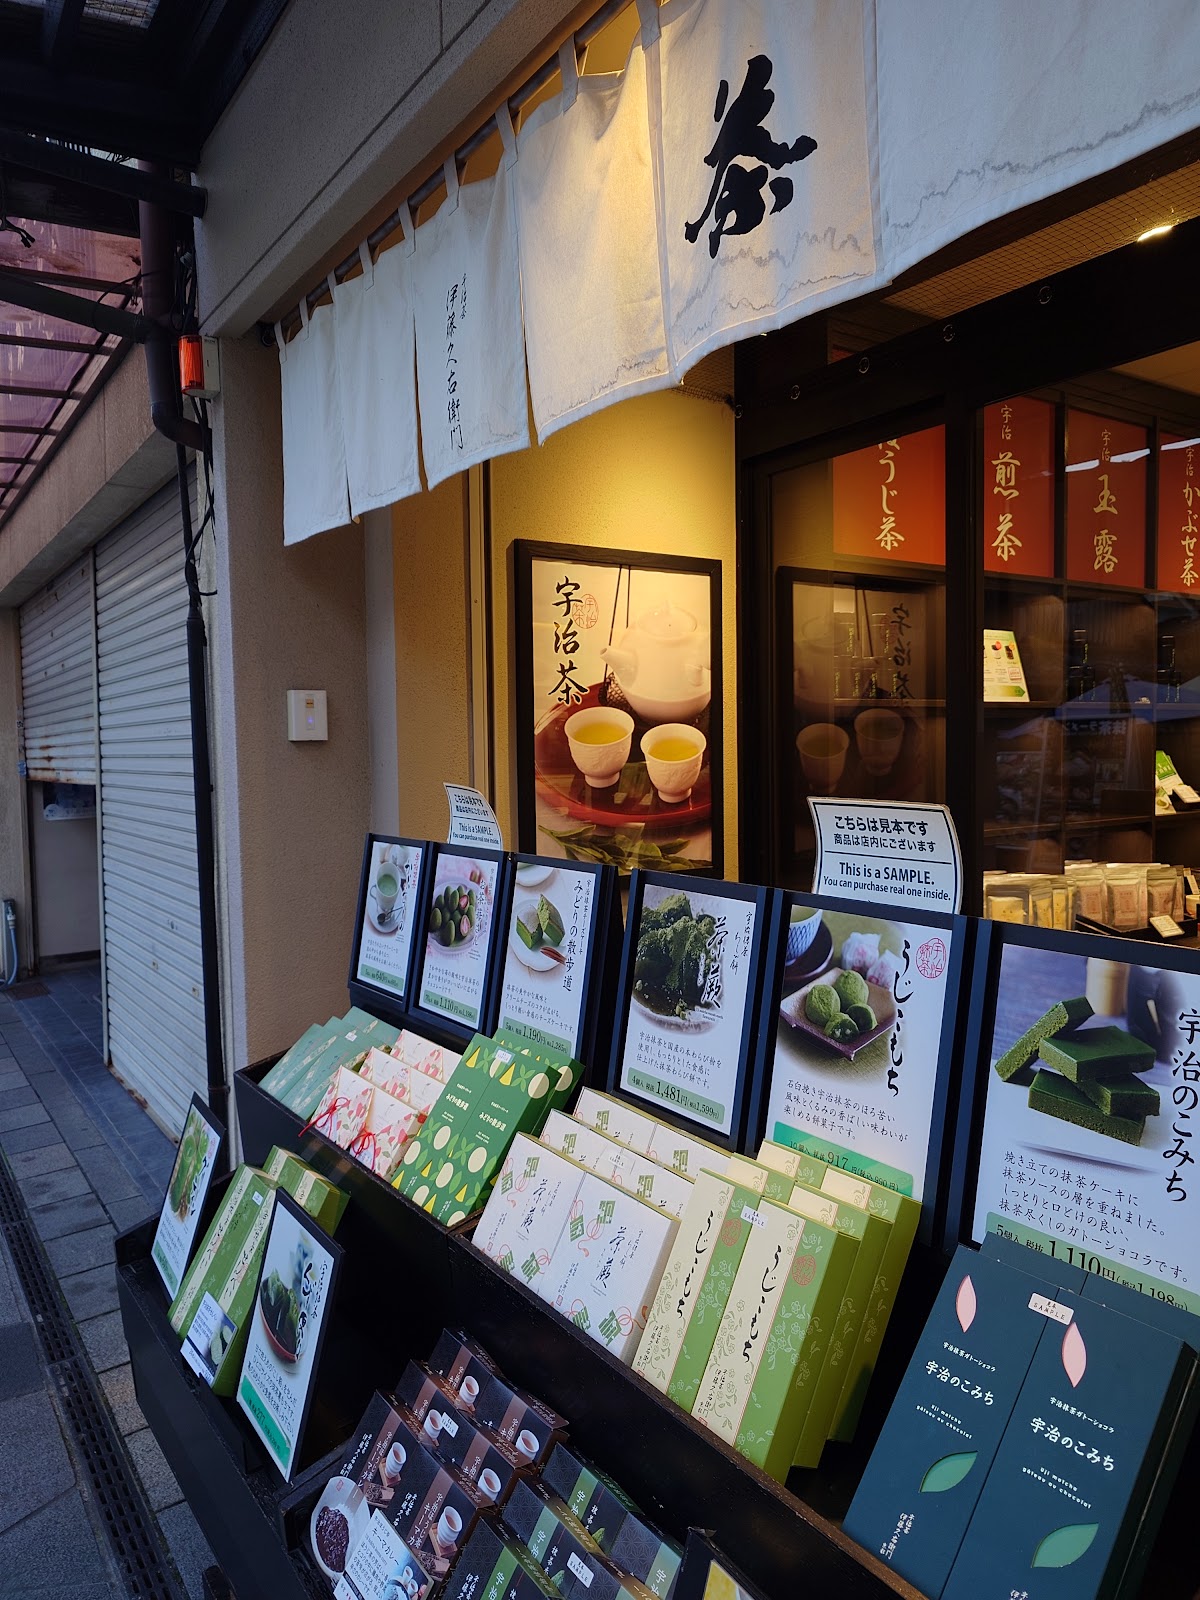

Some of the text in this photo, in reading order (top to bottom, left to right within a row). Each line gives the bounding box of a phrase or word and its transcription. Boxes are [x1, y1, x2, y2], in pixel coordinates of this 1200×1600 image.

[684, 54, 818, 259] 茶
[1000, 404, 1013, 440] 宇治
[1101, 429, 1112, 462] 宇治
[991, 452, 1022, 561] 煎茶
[1093, 474, 1118, 573] 玉露
[1180, 483, 1200, 587] かぶせ茶
[548, 575, 589, 706] 宇治茶
[834, 816, 928, 836] こちらは見本です
[834, 833, 936, 852] 商品は店内にございます
[823, 876, 951, 901] You can purchase real one inside.
[839, 862, 935, 885] This is a SAMPLE.
[563, 880, 584, 992] みどりの散歩道
[784, 1105, 856, 1140] 楽しめる餅菓子です。
[785, 1092, 908, 1142] 風味とくるみの香ばしい味わいが
[787, 1079, 896, 1123] 石臼挽き宇治抹茶のほろ苦い
[1163, 1008, 1200, 1202] 宇治のこみち
[827, 1151, 849, 1169] 917
[1004, 1150, 1139, 1206] 焼き立ての抹茶ケーキに
[1002, 1166, 1165, 1236] 抹茶ソースの層を重ねました。
[1003, 1183, 1129, 1242] しっとりと口どけの良い、
[998, 1197, 1187, 1283] 抹茶尽くしのガトーショコラです。
[1033, 1302, 1066, 1320] SAMPLE
[925, 1360, 994, 1406] 宇治のこみち
[1050, 1396, 1115, 1433] 宇治抹茶ガトーショコラ
[1030, 1417, 1115, 1471] 宇治のこみち
[372, 1528, 399, 1566] キーマカレー
